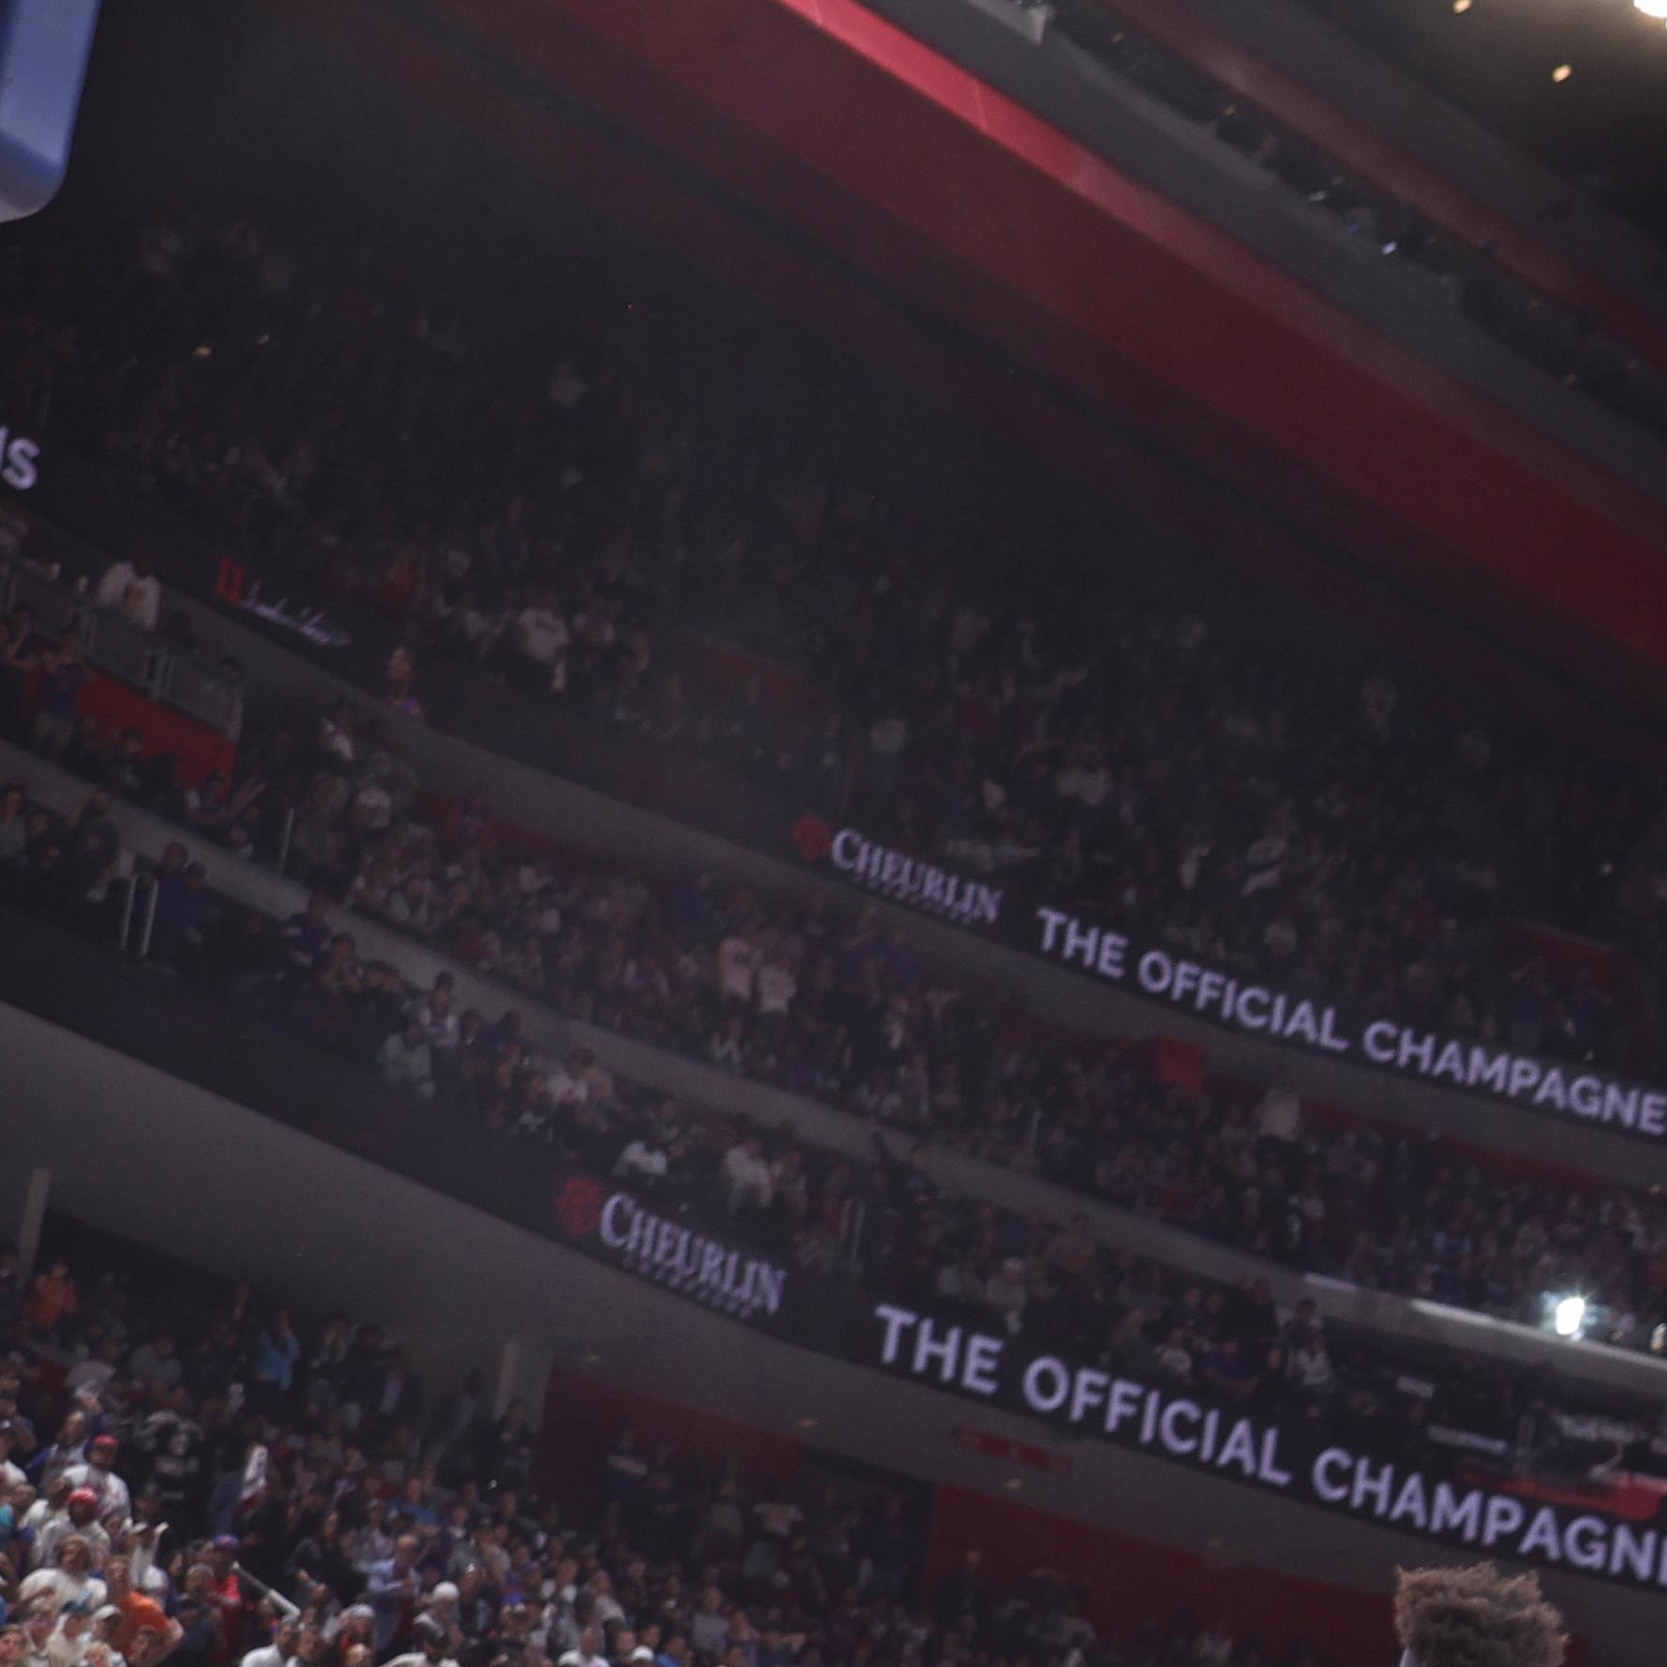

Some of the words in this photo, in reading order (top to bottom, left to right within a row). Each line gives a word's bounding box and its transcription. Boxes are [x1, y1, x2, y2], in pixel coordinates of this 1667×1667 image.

[1035, 905, 1130, 979] THE
[1138, 950, 1349, 1052] OFFICIAL
[875, 1304, 1004, 1396] THE
[1021, 1356, 1291, 1487] OFFICIAL
